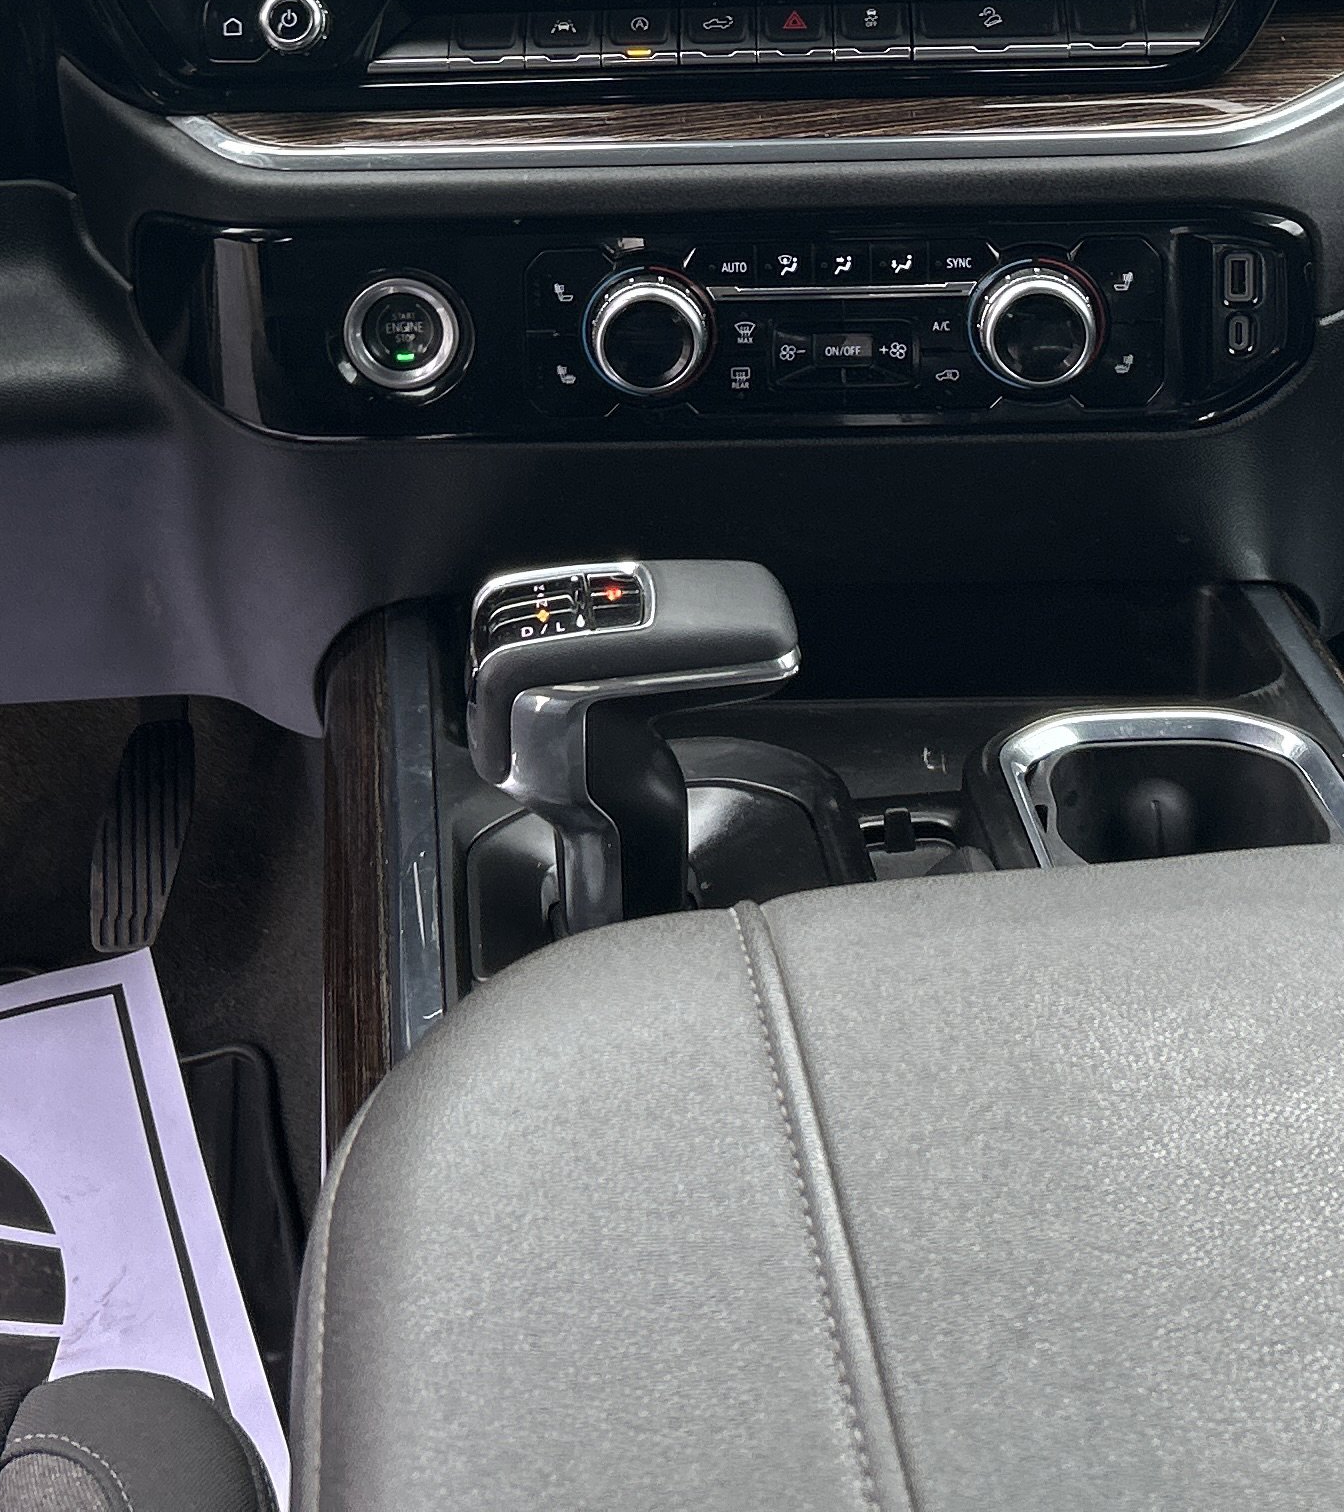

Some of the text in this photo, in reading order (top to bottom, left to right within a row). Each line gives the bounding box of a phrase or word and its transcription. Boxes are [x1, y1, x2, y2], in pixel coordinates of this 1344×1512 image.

[721, 261, 747, 273] AUTO
[946, 257, 972, 269] SYNC
[385, 321, 424, 335] ENGINE
[932, 320, 951, 332] A/C
[825, 346, 861, 357] ON/OFF
